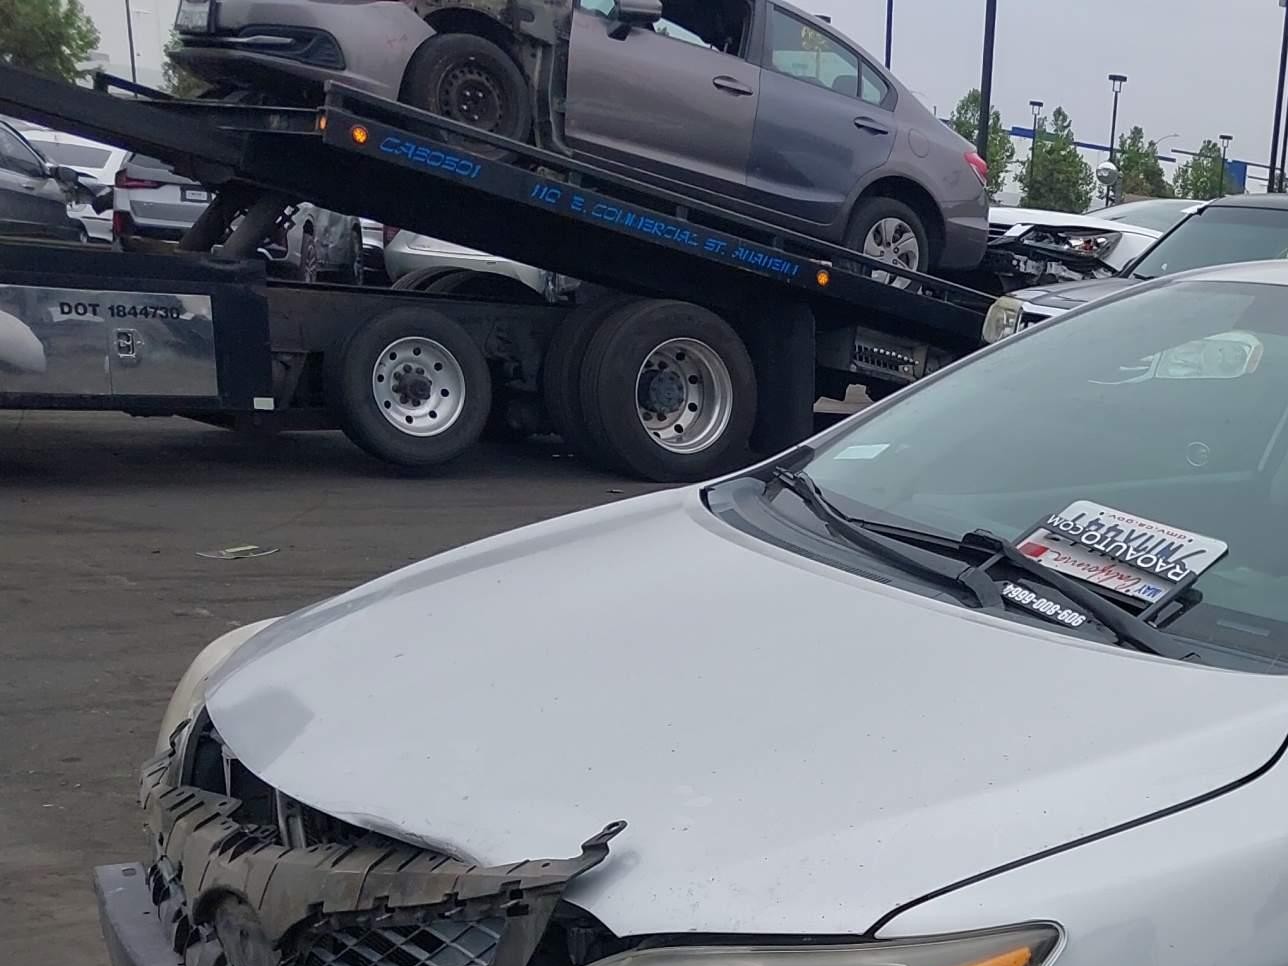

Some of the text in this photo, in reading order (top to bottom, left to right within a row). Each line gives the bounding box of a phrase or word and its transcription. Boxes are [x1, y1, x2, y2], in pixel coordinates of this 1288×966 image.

[60, 302, 180, 319] DOT 1844730
[1047, 514, 1190, 582] RAOAUTO.COM
[1108, 514, 1187, 540] dmv.ca.gov
[1050, 549, 1161, 599] California MAY
[1002, 583, 1087, 627] 909-800-6664
